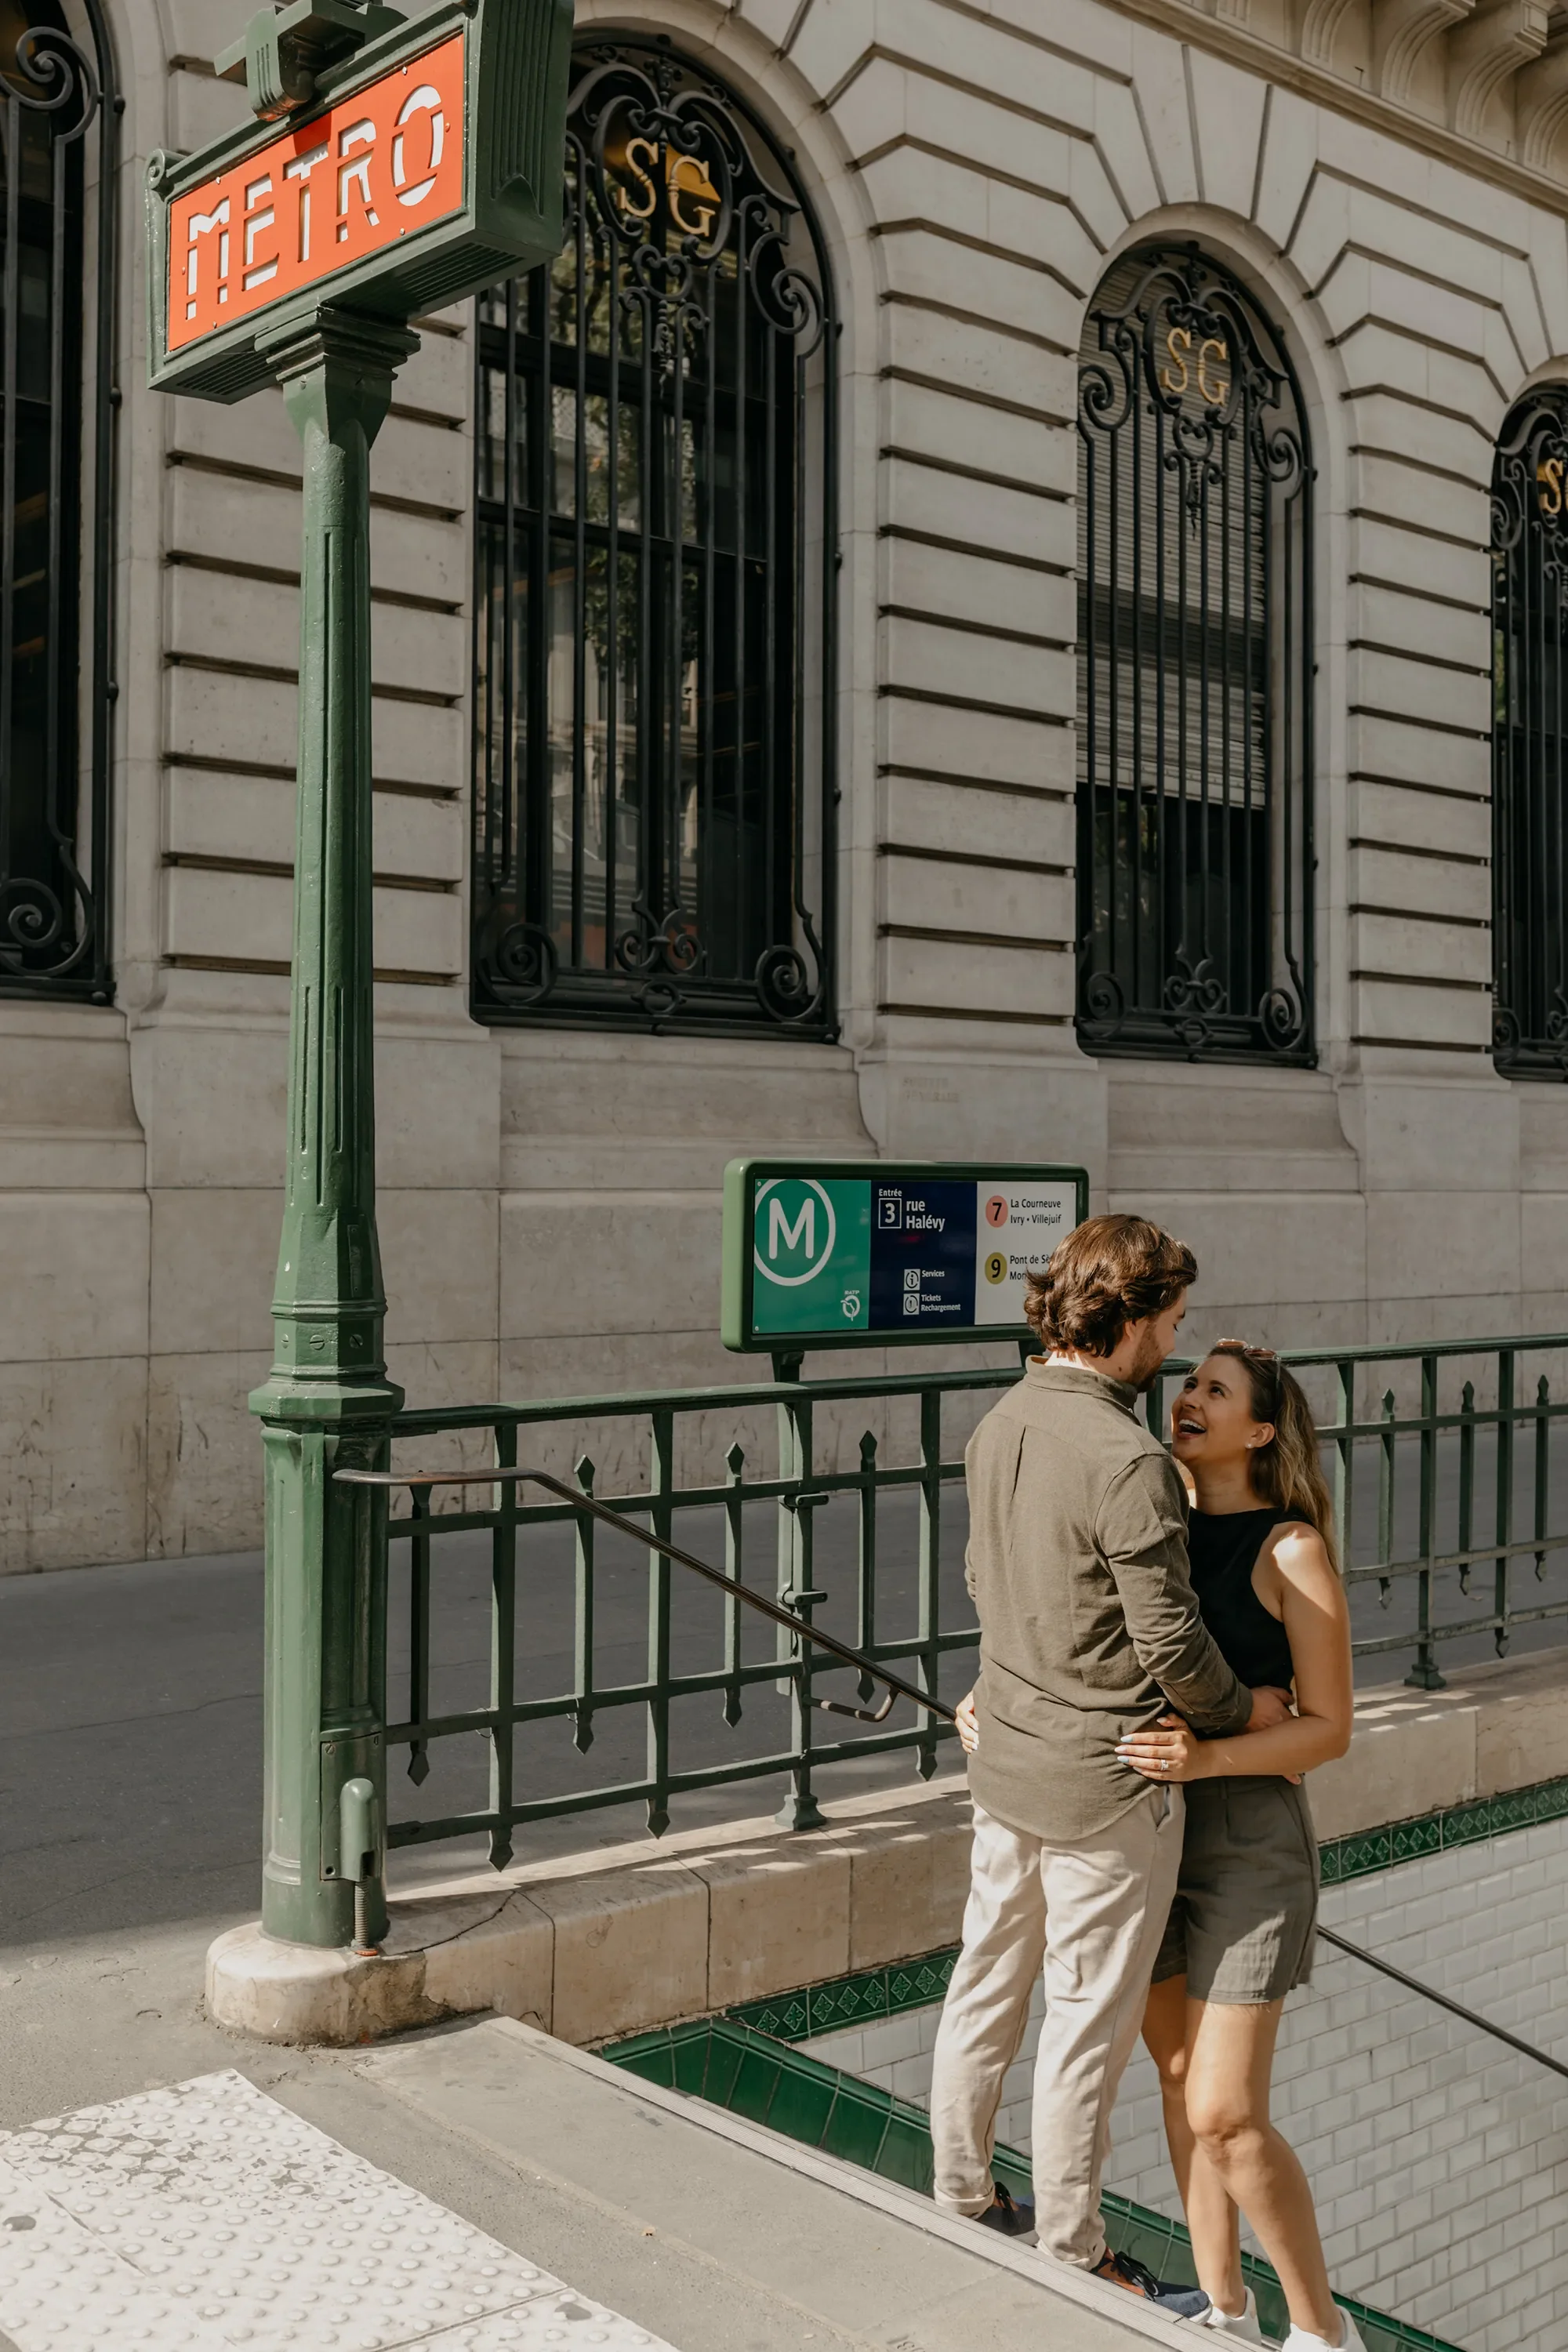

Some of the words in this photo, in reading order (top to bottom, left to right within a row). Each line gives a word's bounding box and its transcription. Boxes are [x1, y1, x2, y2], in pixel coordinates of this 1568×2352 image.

[617, 136, 716, 237] SG
[185, 84, 445, 321] METRO
[1160, 327, 1229, 406] SG
[878, 1189, 902, 1197] Entrée
[906, 1200, 926, 1212] rue
[1010, 1199, 1019, 1208] La
[1021, 1199, 1062, 1208] Courneuve
[884, 1203, 896, 1224] 3
[992, 1202, 1003, 1221] 7
[906, 1214, 946, 1232] Halévy
[1010, 1214, 1025, 1226] Ivry
[1031, 1214, 1062, 1226] Villejuif
[768, 1197, 815, 1260] M
[1009, 1255, 1028, 1265] Pont
[1029, 1254, 1040, 1264] de
[921, 1269, 946, 1278] Services
[991, 1258, 1001, 1279] 9
[920, 1294, 942, 1302] Tickets
[920, 1303, 961, 1313] Rechargement
